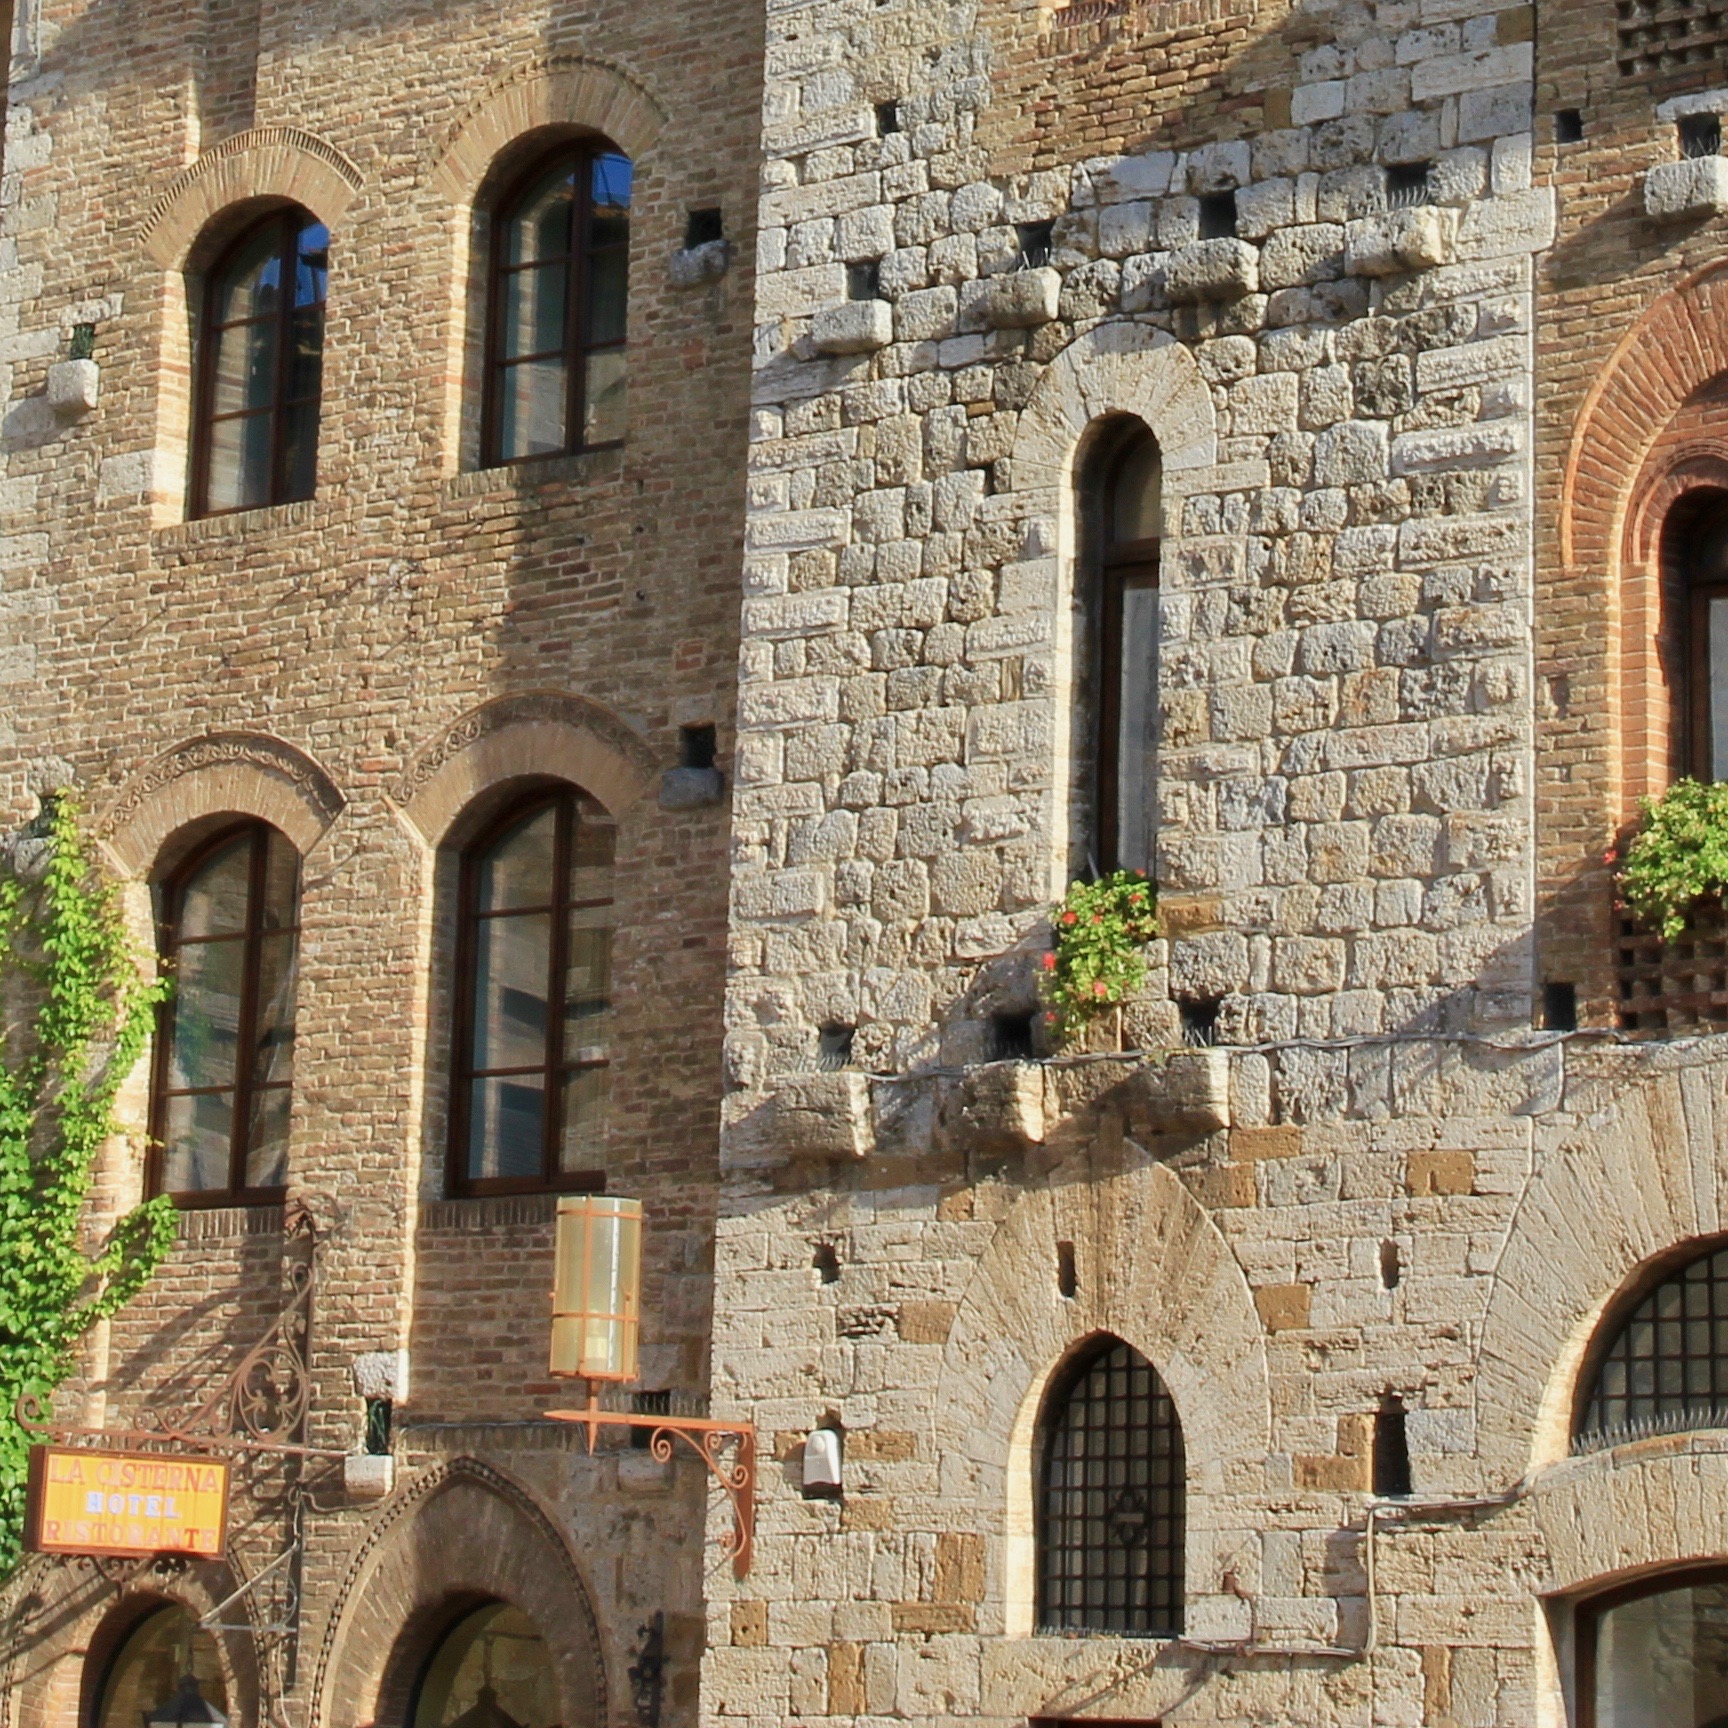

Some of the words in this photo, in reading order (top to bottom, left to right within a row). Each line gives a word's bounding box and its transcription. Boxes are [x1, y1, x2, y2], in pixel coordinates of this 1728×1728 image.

[49, 1457, 86, 1485] LA
[96, 1460, 220, 1494] CISTERNA
[85, 1490, 181, 1519] HOTEL
[45, 1520, 217, 1550] RISTORANTE
